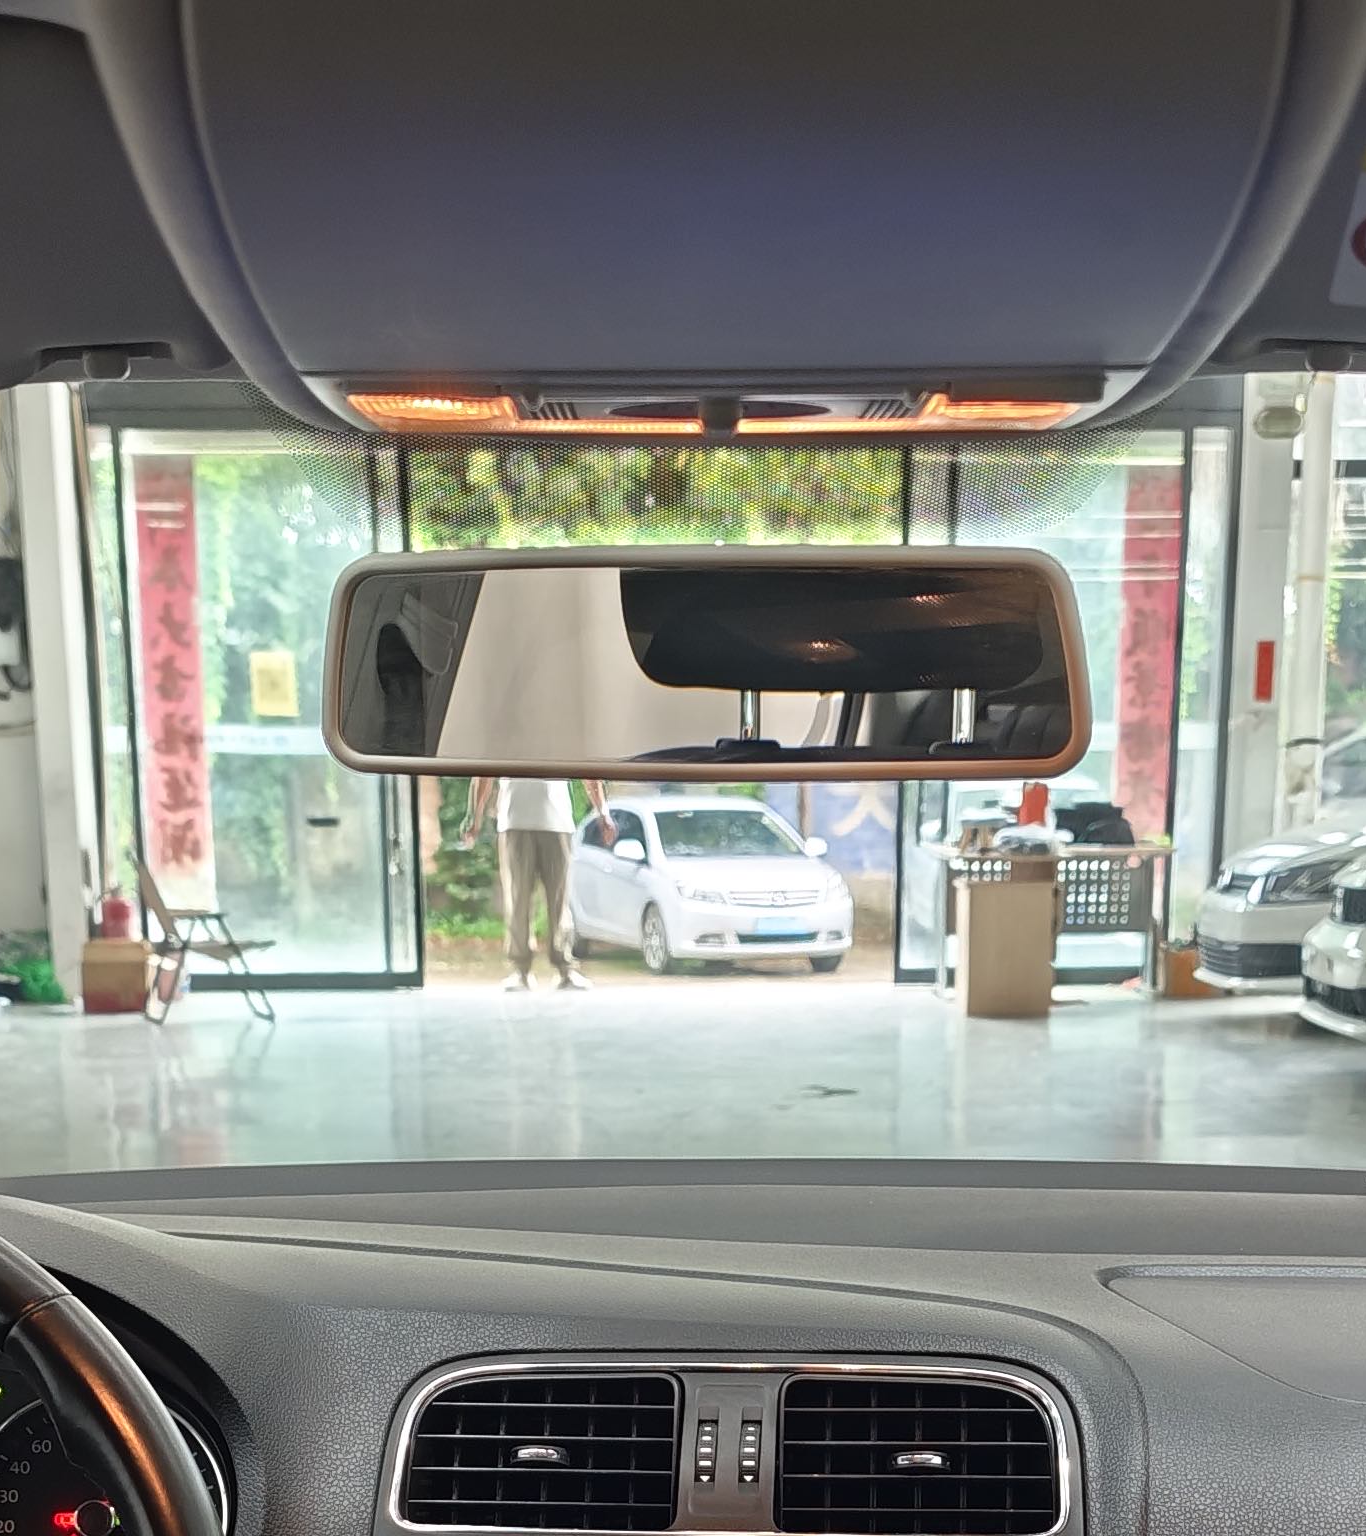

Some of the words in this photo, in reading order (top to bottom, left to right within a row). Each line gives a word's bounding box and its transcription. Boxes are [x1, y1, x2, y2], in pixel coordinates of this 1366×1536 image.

[31, 1439, 52, 1454] 60
[9, 1460, 30, 1475] 40
[0, 1489, 19, 1503] 30
